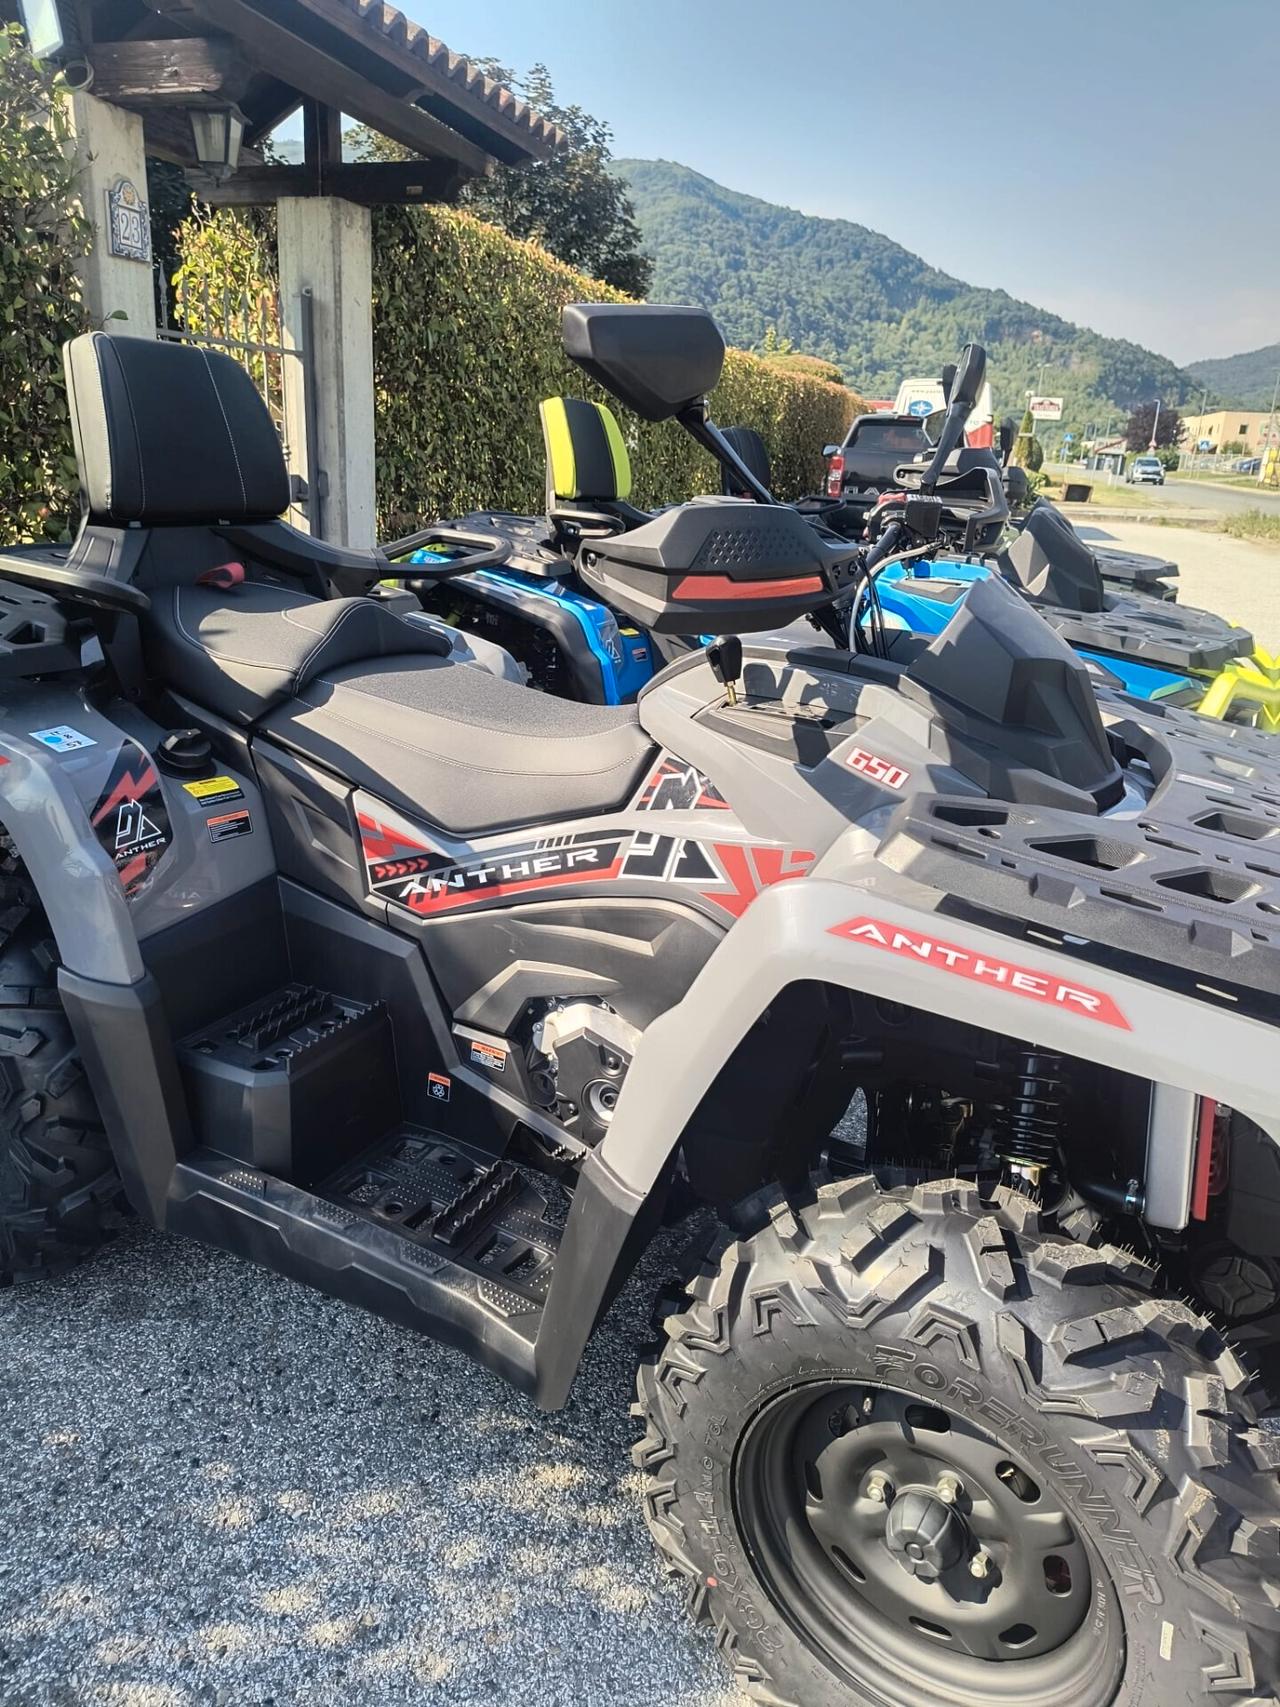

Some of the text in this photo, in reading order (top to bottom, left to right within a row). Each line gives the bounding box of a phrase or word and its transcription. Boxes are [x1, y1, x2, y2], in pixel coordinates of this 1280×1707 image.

[120, 212, 140, 243] 23
[844, 746, 911, 791] 650
[115, 837, 166, 860] ANTHER
[399, 848, 600, 898] ANTHER
[849, 923, 1101, 1013] ANTHER
[867, 1344, 1165, 1606] FORERUNNER
